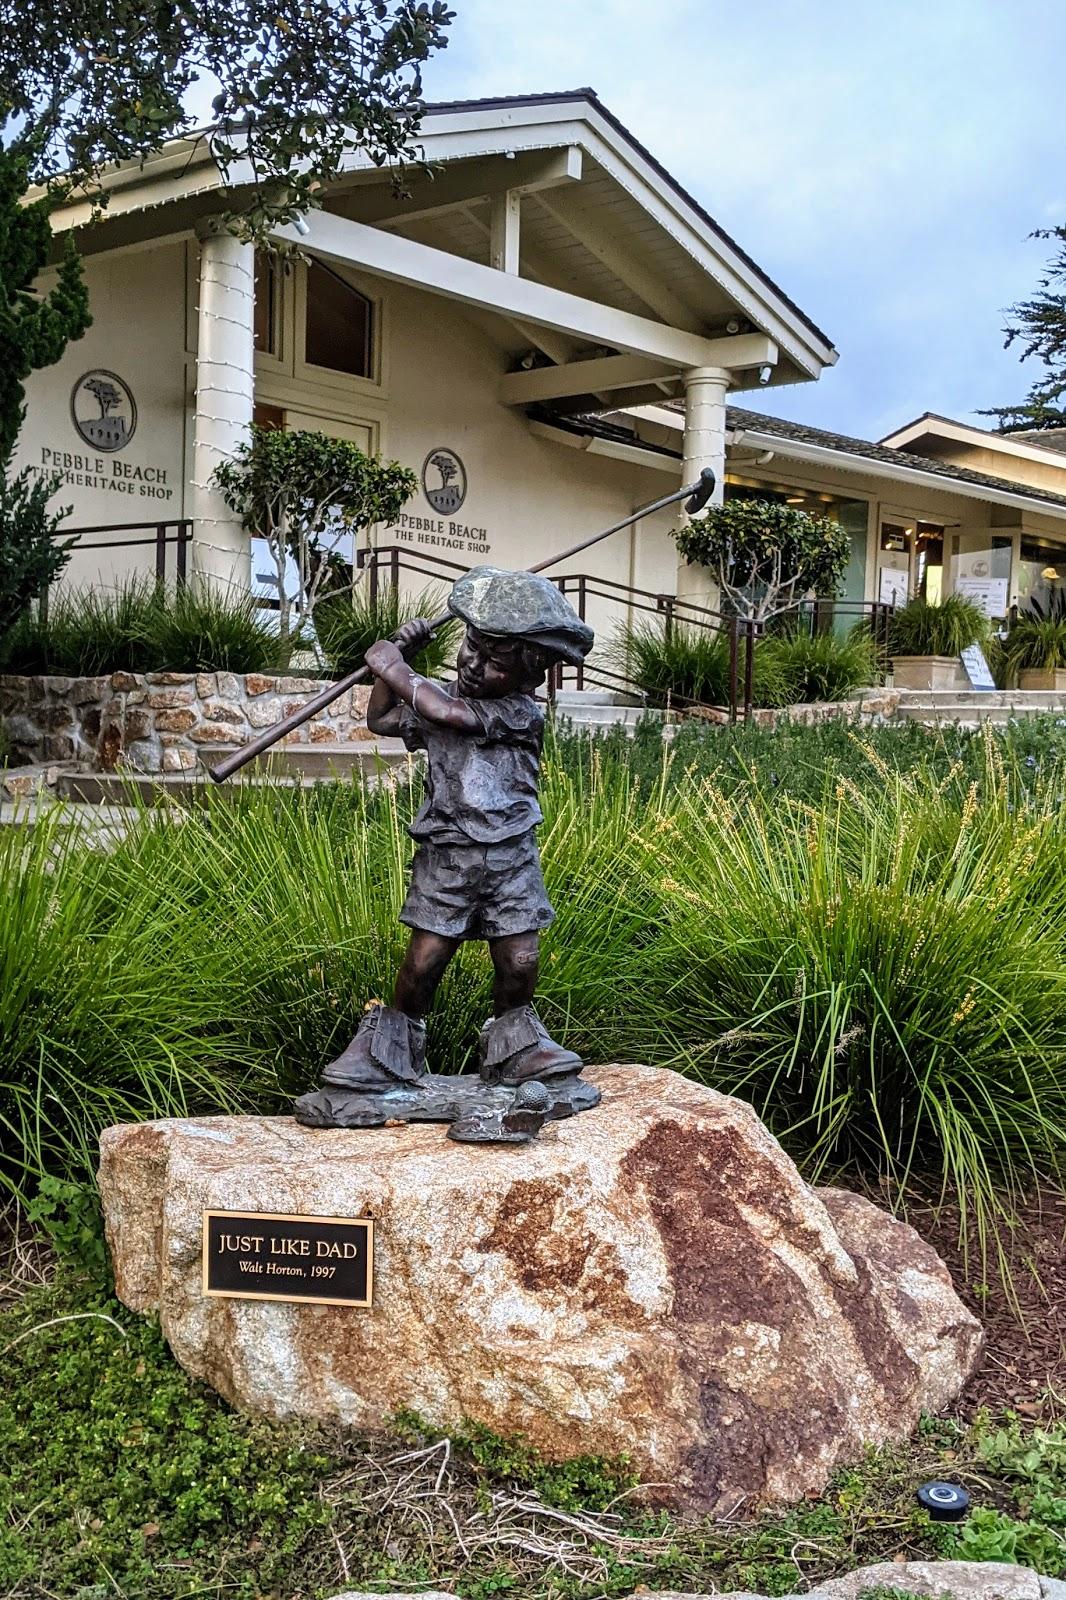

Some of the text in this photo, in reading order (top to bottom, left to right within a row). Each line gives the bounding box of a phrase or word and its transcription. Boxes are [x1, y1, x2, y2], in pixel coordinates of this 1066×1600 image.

[90, 427, 120, 441] 1919
[41, 447, 168, 485] PEBBLE BEACH
[32, 466, 173, 500] THE HERITAGE SHOP
[400, 514, 487, 541] PEBBLE BEACH
[395, 530, 491, 554] THE HERITAGE SHOP
[218, 1234, 357, 1259] JUST LIKE DAD
[239, 1261, 336, 1279] Walt Horton, 1997
